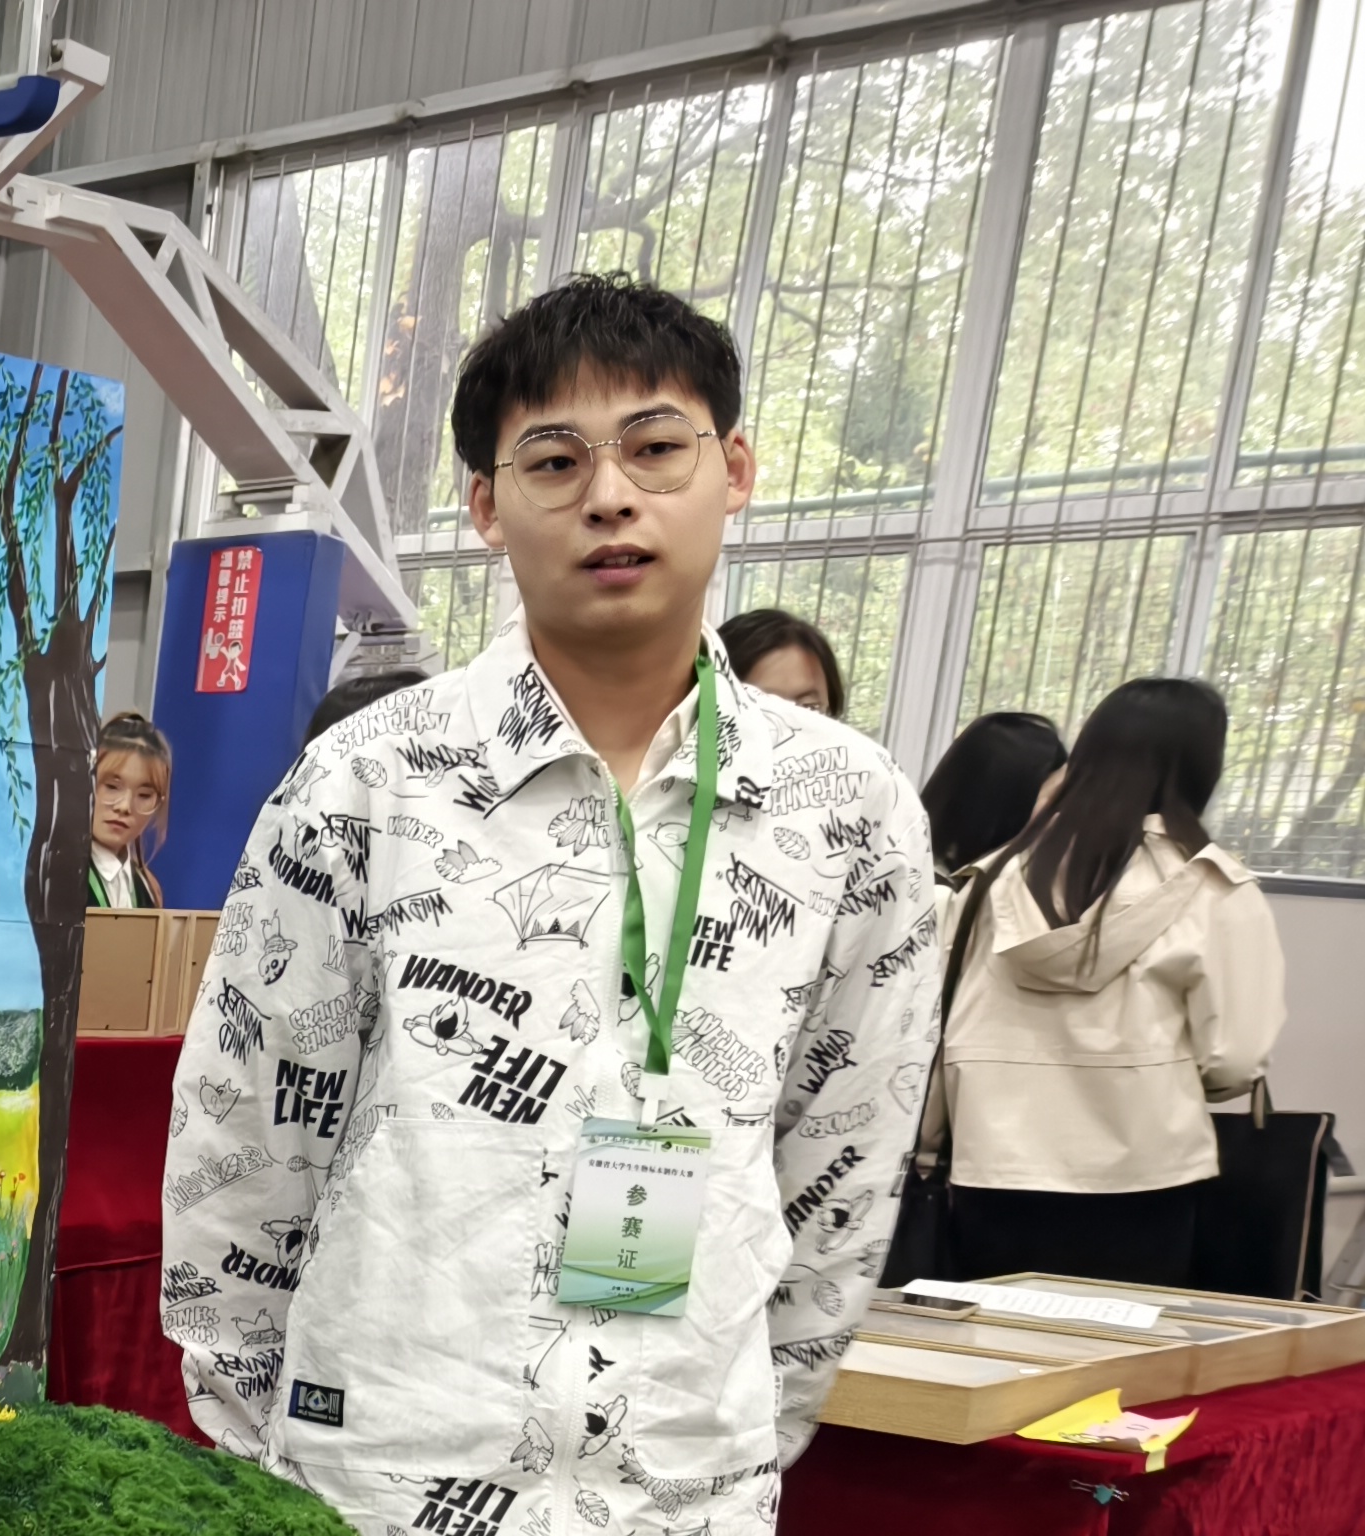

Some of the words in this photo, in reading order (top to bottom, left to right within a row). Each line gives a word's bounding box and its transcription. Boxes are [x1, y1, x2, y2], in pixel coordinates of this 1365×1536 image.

[227, 550, 254, 639] 禁止扣篮
[772, 745, 849, 786] RAYON
[772, 771, 870, 817] HINCHAN
[687, 939, 735, 972] IFE
[397, 954, 533, 1031] WANDER
[275, 1059, 348, 1101] NEW
[470, 1035, 568, 1100] LIFE
[273, 1087, 344, 1138] LIFE
[457, 1074, 548, 1125] NEW
[617, 1183, 648, 1270] 参赛证
